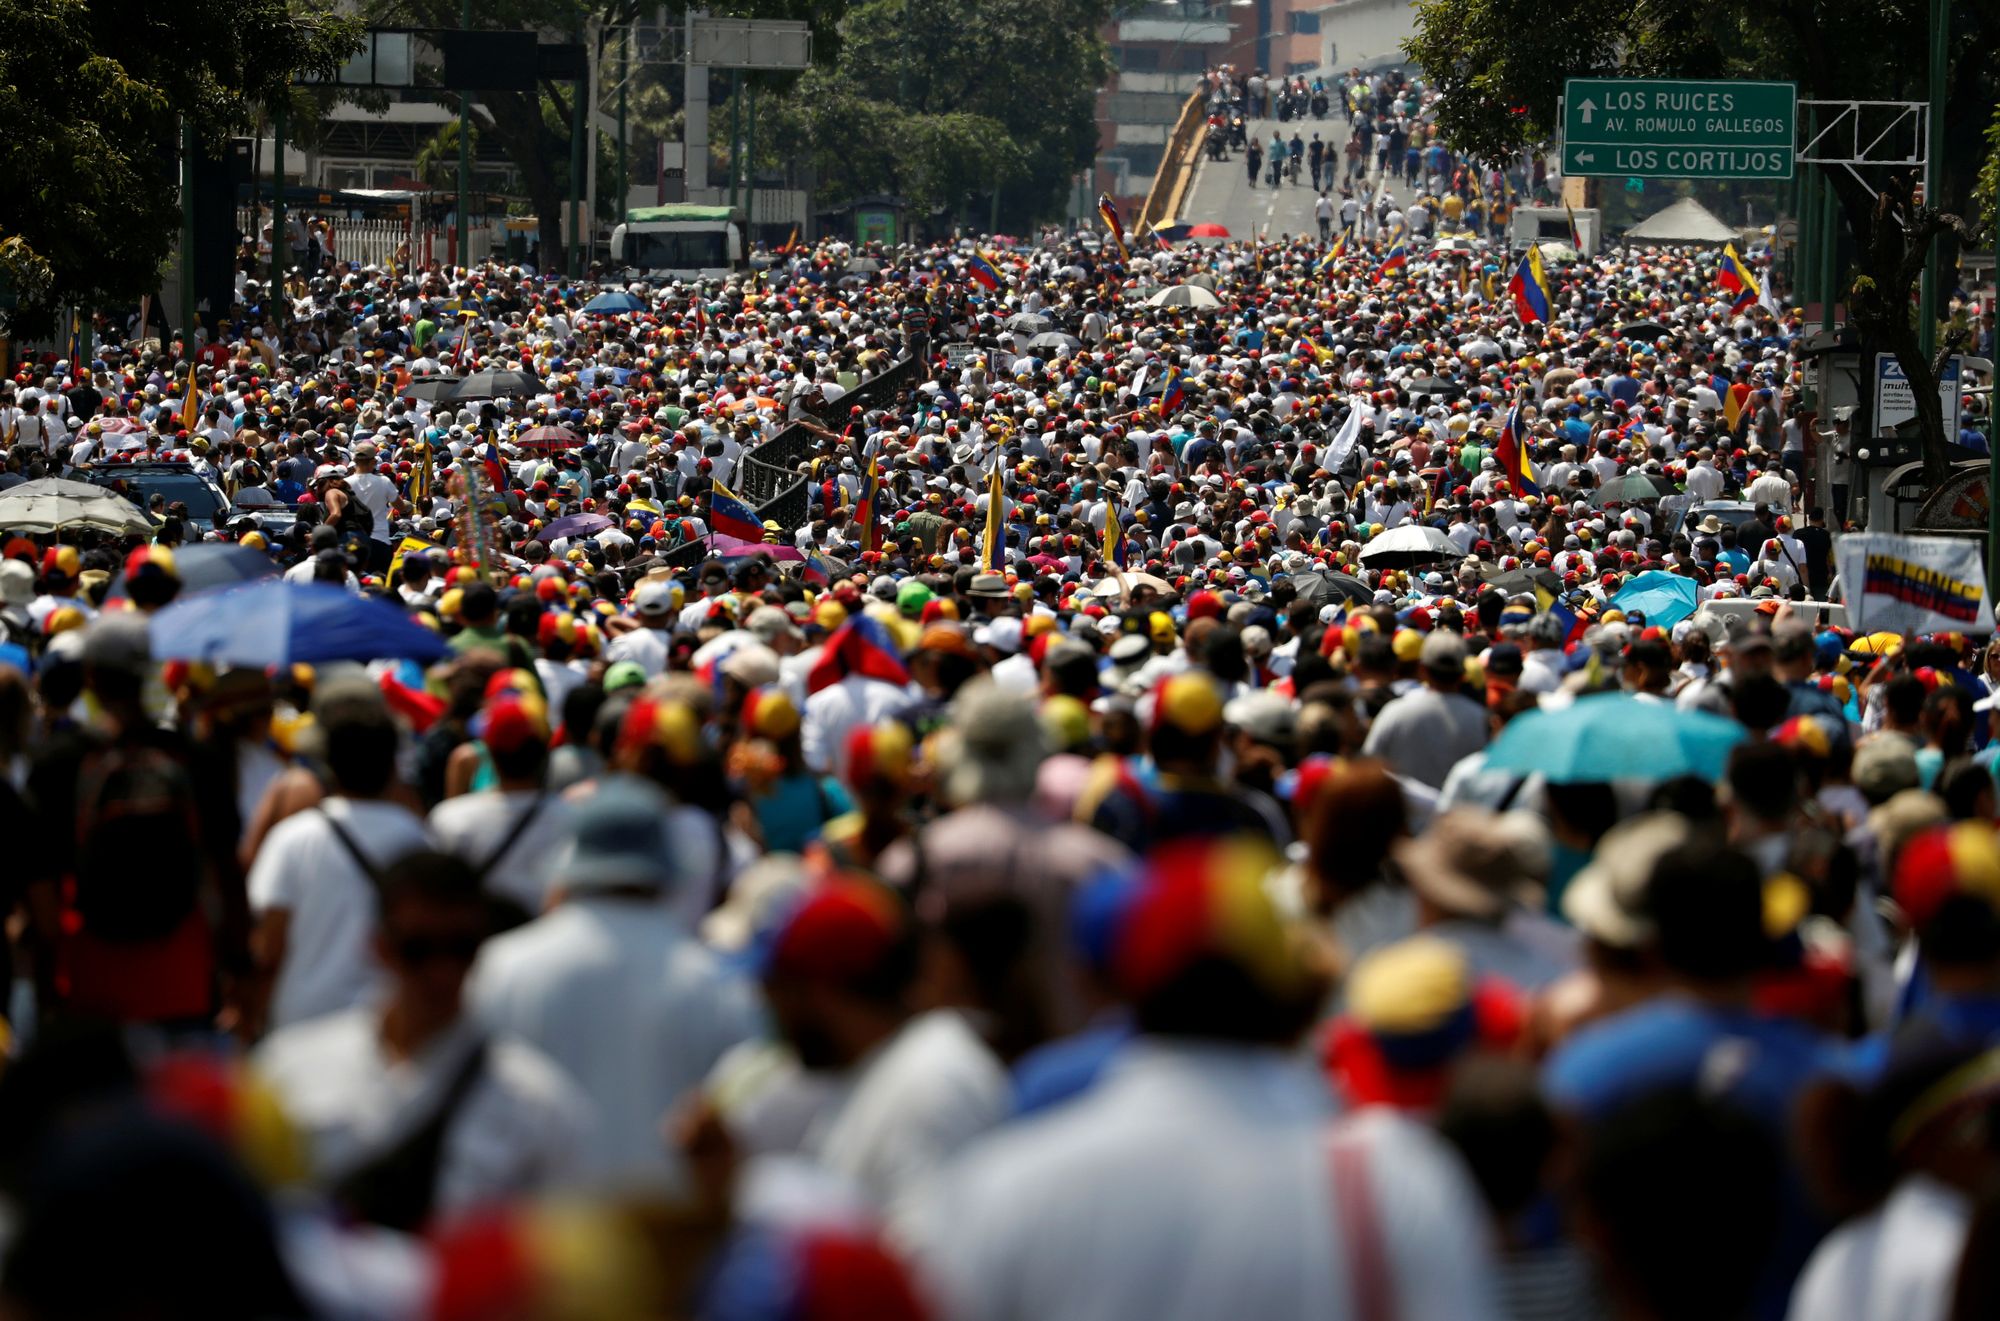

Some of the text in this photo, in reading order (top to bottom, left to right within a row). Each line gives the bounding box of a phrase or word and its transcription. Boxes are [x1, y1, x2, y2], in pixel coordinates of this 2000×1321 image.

[1605, 92, 1734, 112] LOS RUICES
[1605, 118, 1784, 133] AV. ROMULO GALLEGOS
[1616, 150, 1783, 171] LOS CORTIJOS
